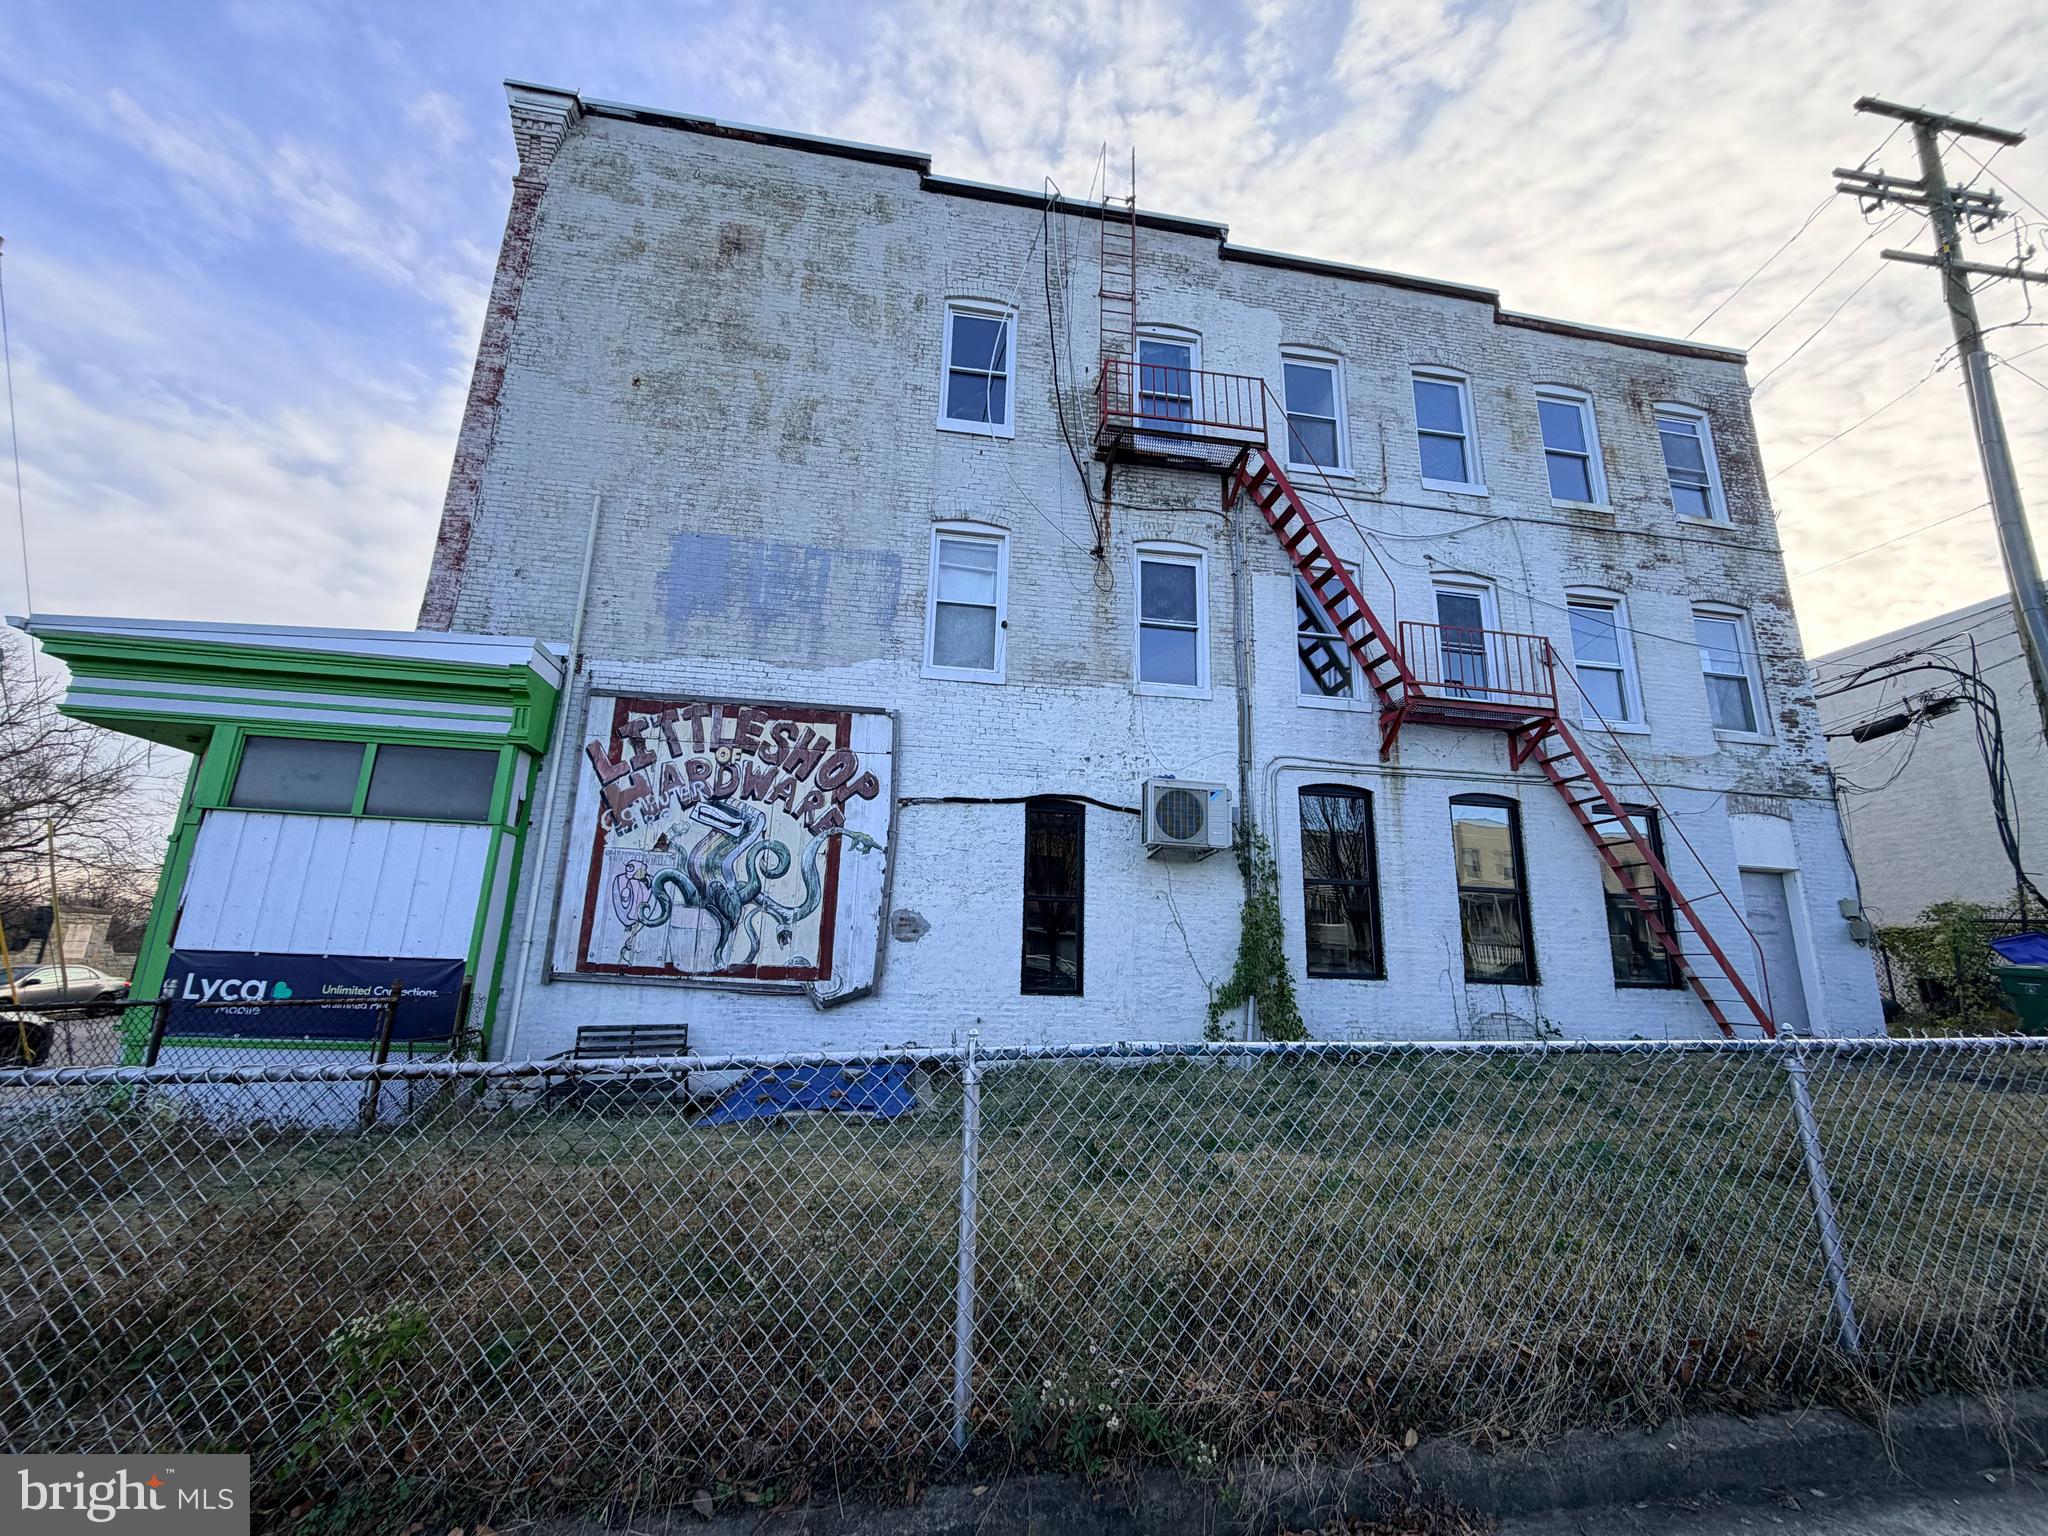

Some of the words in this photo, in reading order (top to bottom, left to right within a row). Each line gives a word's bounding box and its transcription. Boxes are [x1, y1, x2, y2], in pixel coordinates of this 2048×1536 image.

[715, 746, 742, 766] OF
[600, 757, 846, 837] HARDWARE
[182, 972, 268, 1003] Lyca
[322, 984, 371, 995] Unlimited
